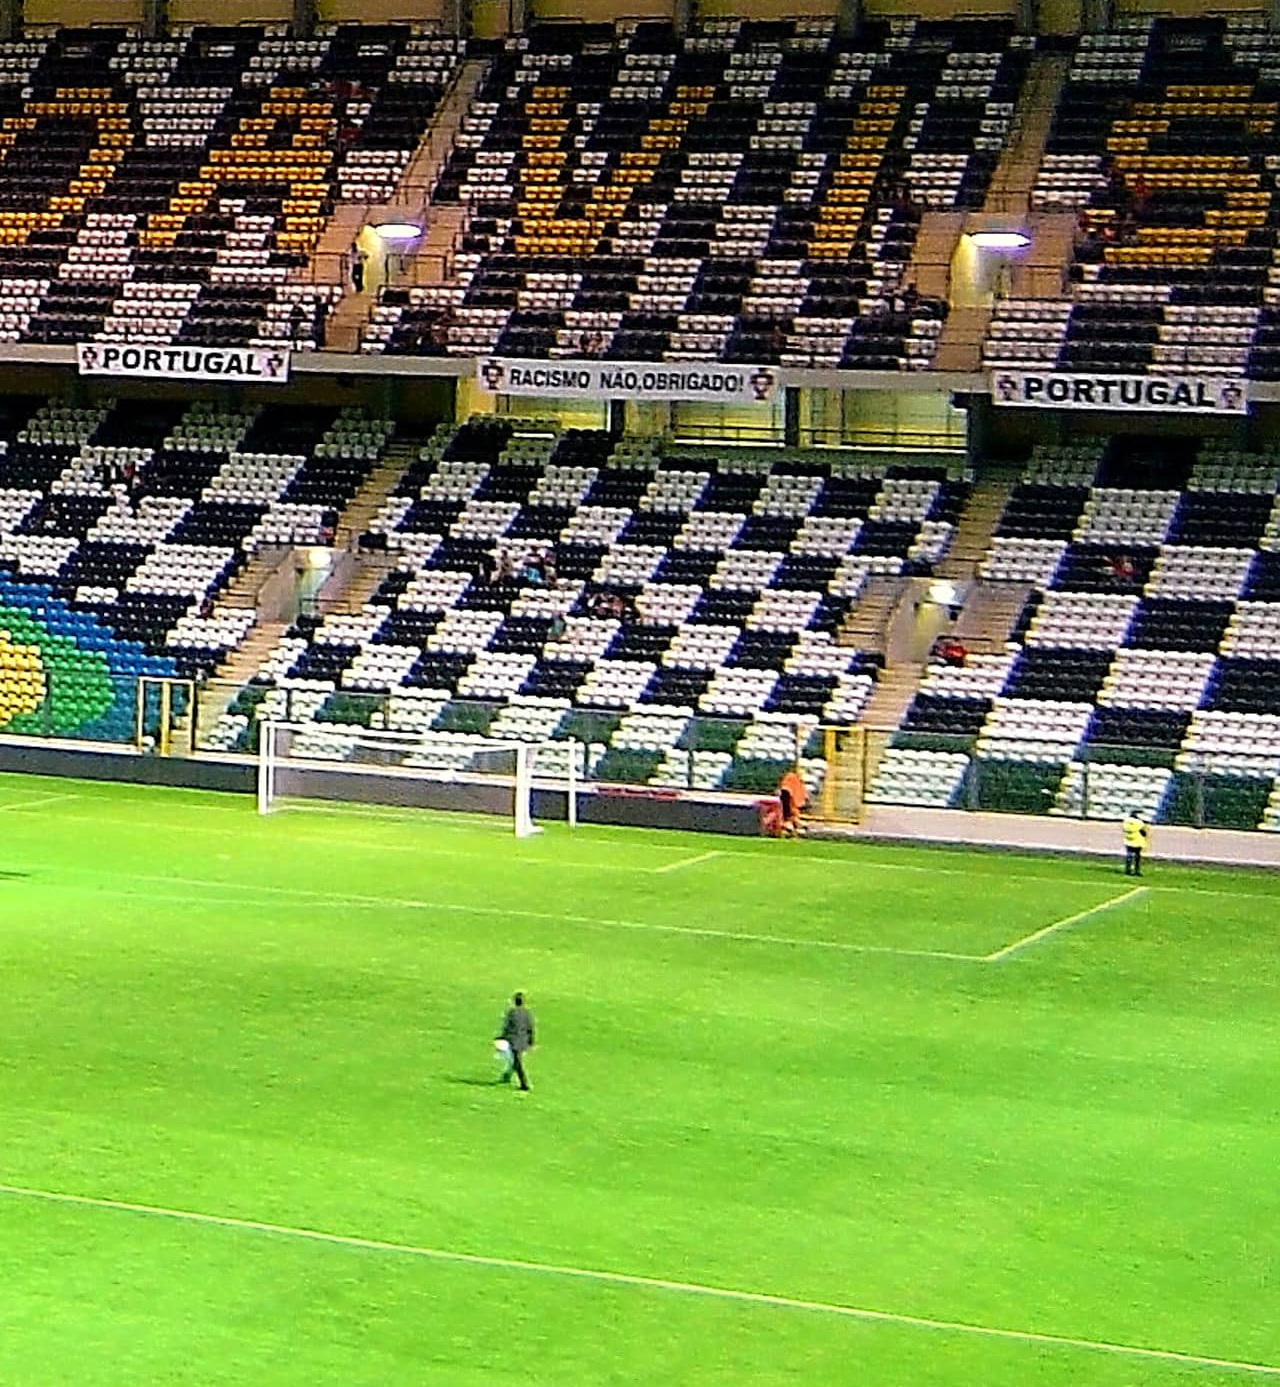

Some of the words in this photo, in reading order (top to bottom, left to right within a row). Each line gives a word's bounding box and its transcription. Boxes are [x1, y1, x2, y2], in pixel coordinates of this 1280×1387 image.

[102, 347, 263, 375] PORTUGAL
[509, 367, 591, 389] RACISMO
[1023, 377, 1217, 408] PORTUGAL
